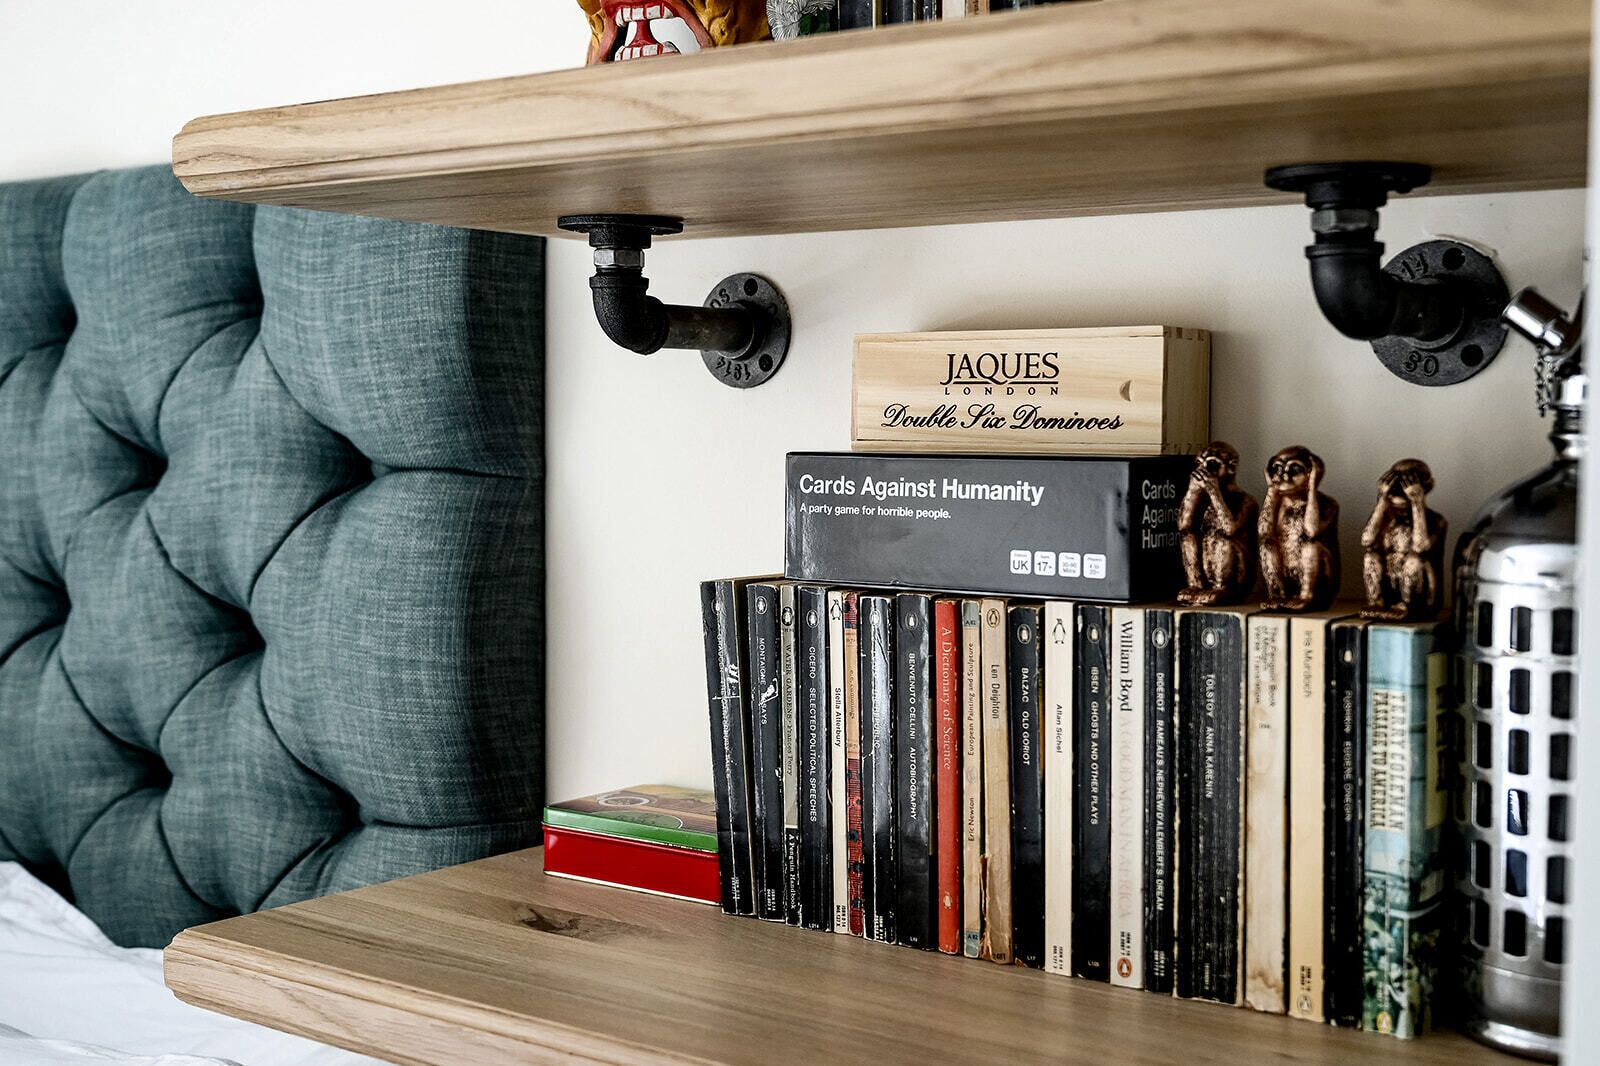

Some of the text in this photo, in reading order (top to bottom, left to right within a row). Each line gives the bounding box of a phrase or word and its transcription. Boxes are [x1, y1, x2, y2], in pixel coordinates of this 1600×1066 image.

[940, 352, 1059, 386] JAQUES
[944, 387, 1058, 396] LONDON
[881, 403, 1124, 430] Double Six Dominoes
[799, 473, 1045, 506] Cards Against Humanity
[800, 503, 951, 520] A party game for horrible people.
[1142, 479, 1176, 500] Cards
[1013, 560, 1028, 571] UK
[1120, 620, 1133, 674] William
[1269, 626, 1277, 642] The
[759, 638, 767, 685] MONTAIGNE
[1303, 630, 1313, 697] Iris Murdoch
[809, 687, 817, 731] SELECTED
[940, 627, 954, 770] A Dictionary of Science
[967, 643, 976, 756] European Painting and Sculpture
[991, 664, 1001, 719] Len Deighton
[1117, 678, 1133, 712] Boyd
[1156, 672, 1164, 712] DIDEROT
[786, 724, 794, 753] Frances
[833, 687, 843, 747] Stella Atterbury
[873, 707, 881, 749] REPUBLIC
[908, 653, 917, 820] BENVENUTO CELLINI AUTOBIOGRAPHY
[1021, 667, 1030, 766] BALZAC OLD GORIOT
[1205, 673, 1214, 798] TOLSTOY ANNA KARENIN
[809, 733, 817, 775] POLITICAL
[1090, 666, 1098, 825] IBSEN GHOSTS AND OTHER PLAYS
[1156, 719, 1164, 765] RAMEAU'S
[1370, 691, 1388, 828] PASSAGE TO AMERICA
[1389, 693, 1405, 830] TERRY COLEMAN
[785, 755, 794, 777] Perry
[809, 777, 818, 822] SPEECHES
[967, 797, 975, 842] Eric Newton
[1156, 879, 1164, 911] DREAM
